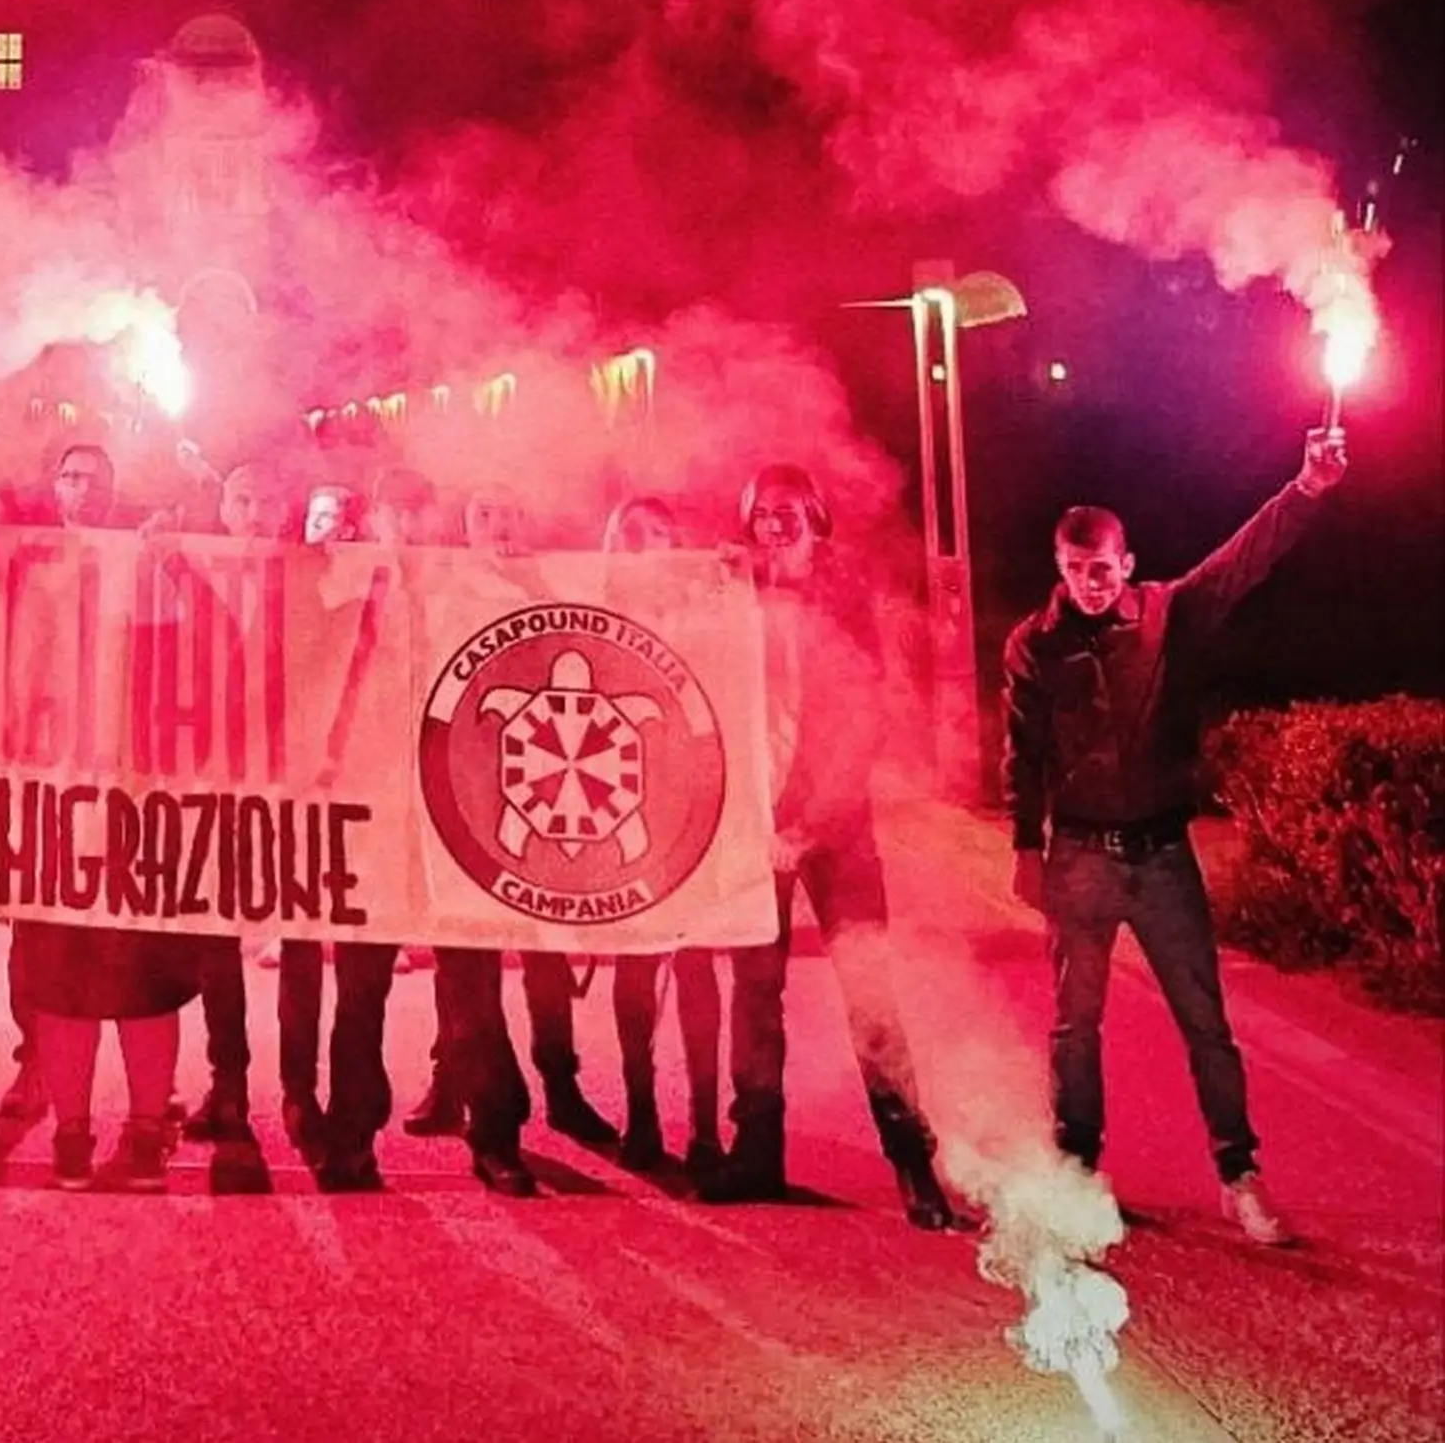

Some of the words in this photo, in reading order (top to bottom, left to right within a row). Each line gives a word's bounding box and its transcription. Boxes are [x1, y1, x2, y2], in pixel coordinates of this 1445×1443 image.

[454, 609, 609, 683] CASAPOUND
[616, 622, 687, 694] ITALIA
[501, 879, 646, 919] CAMPANIA
